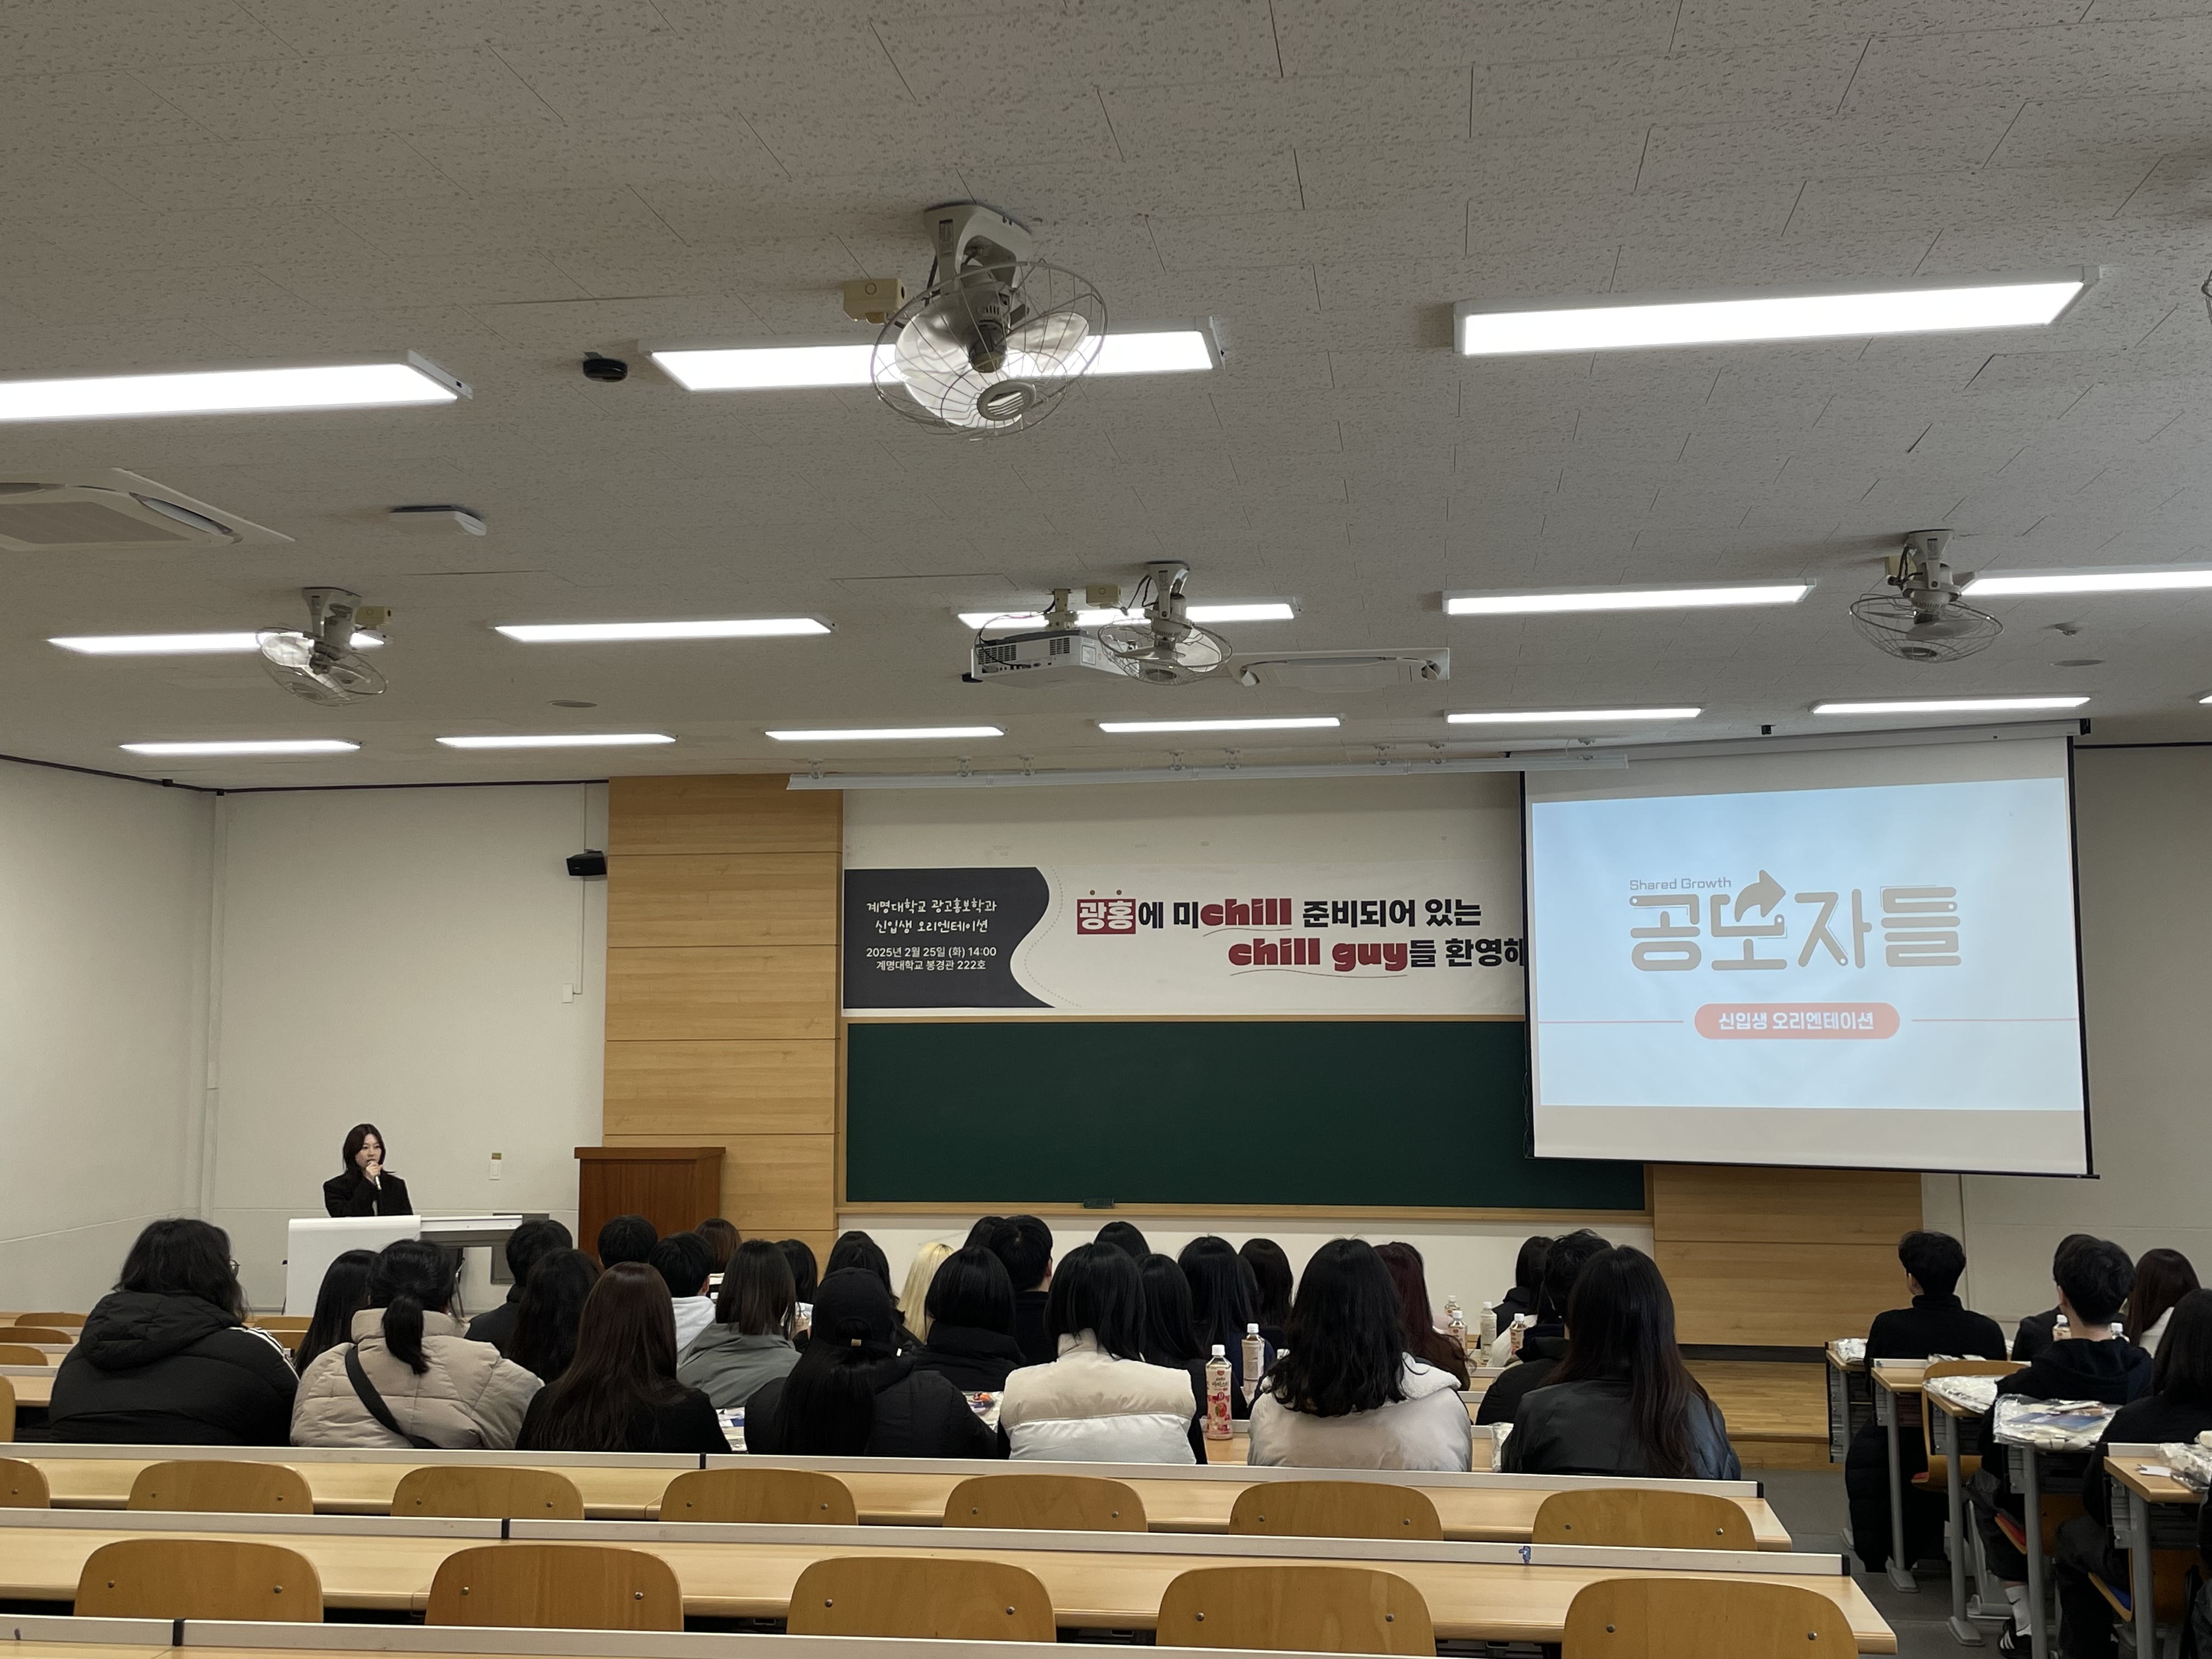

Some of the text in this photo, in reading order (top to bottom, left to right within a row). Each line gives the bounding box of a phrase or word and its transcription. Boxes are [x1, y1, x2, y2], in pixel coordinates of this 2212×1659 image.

[1629, 876, 1731, 890] Shared Growth
[866, 897, 997, 914] 계명대학교 광고홍보학과
[1077, 898, 1482, 934] 광홍에 미chill 준비되어 있는
[1629, 870, 1962, 971] 공모자들
[875, 919, 988, 934] 신입생 오리엔테이션
[866, 946, 997, 958] 2025년 2월 25일 (화) 14:00
[1228, 938, 1321, 966] chill
[1332, 939, 1437, 972] guy들
[876, 960, 986, 971] 계명대학교 봉경관 222호
[1718, 1012, 1874, 1030] 신입생 오리엔테이션
